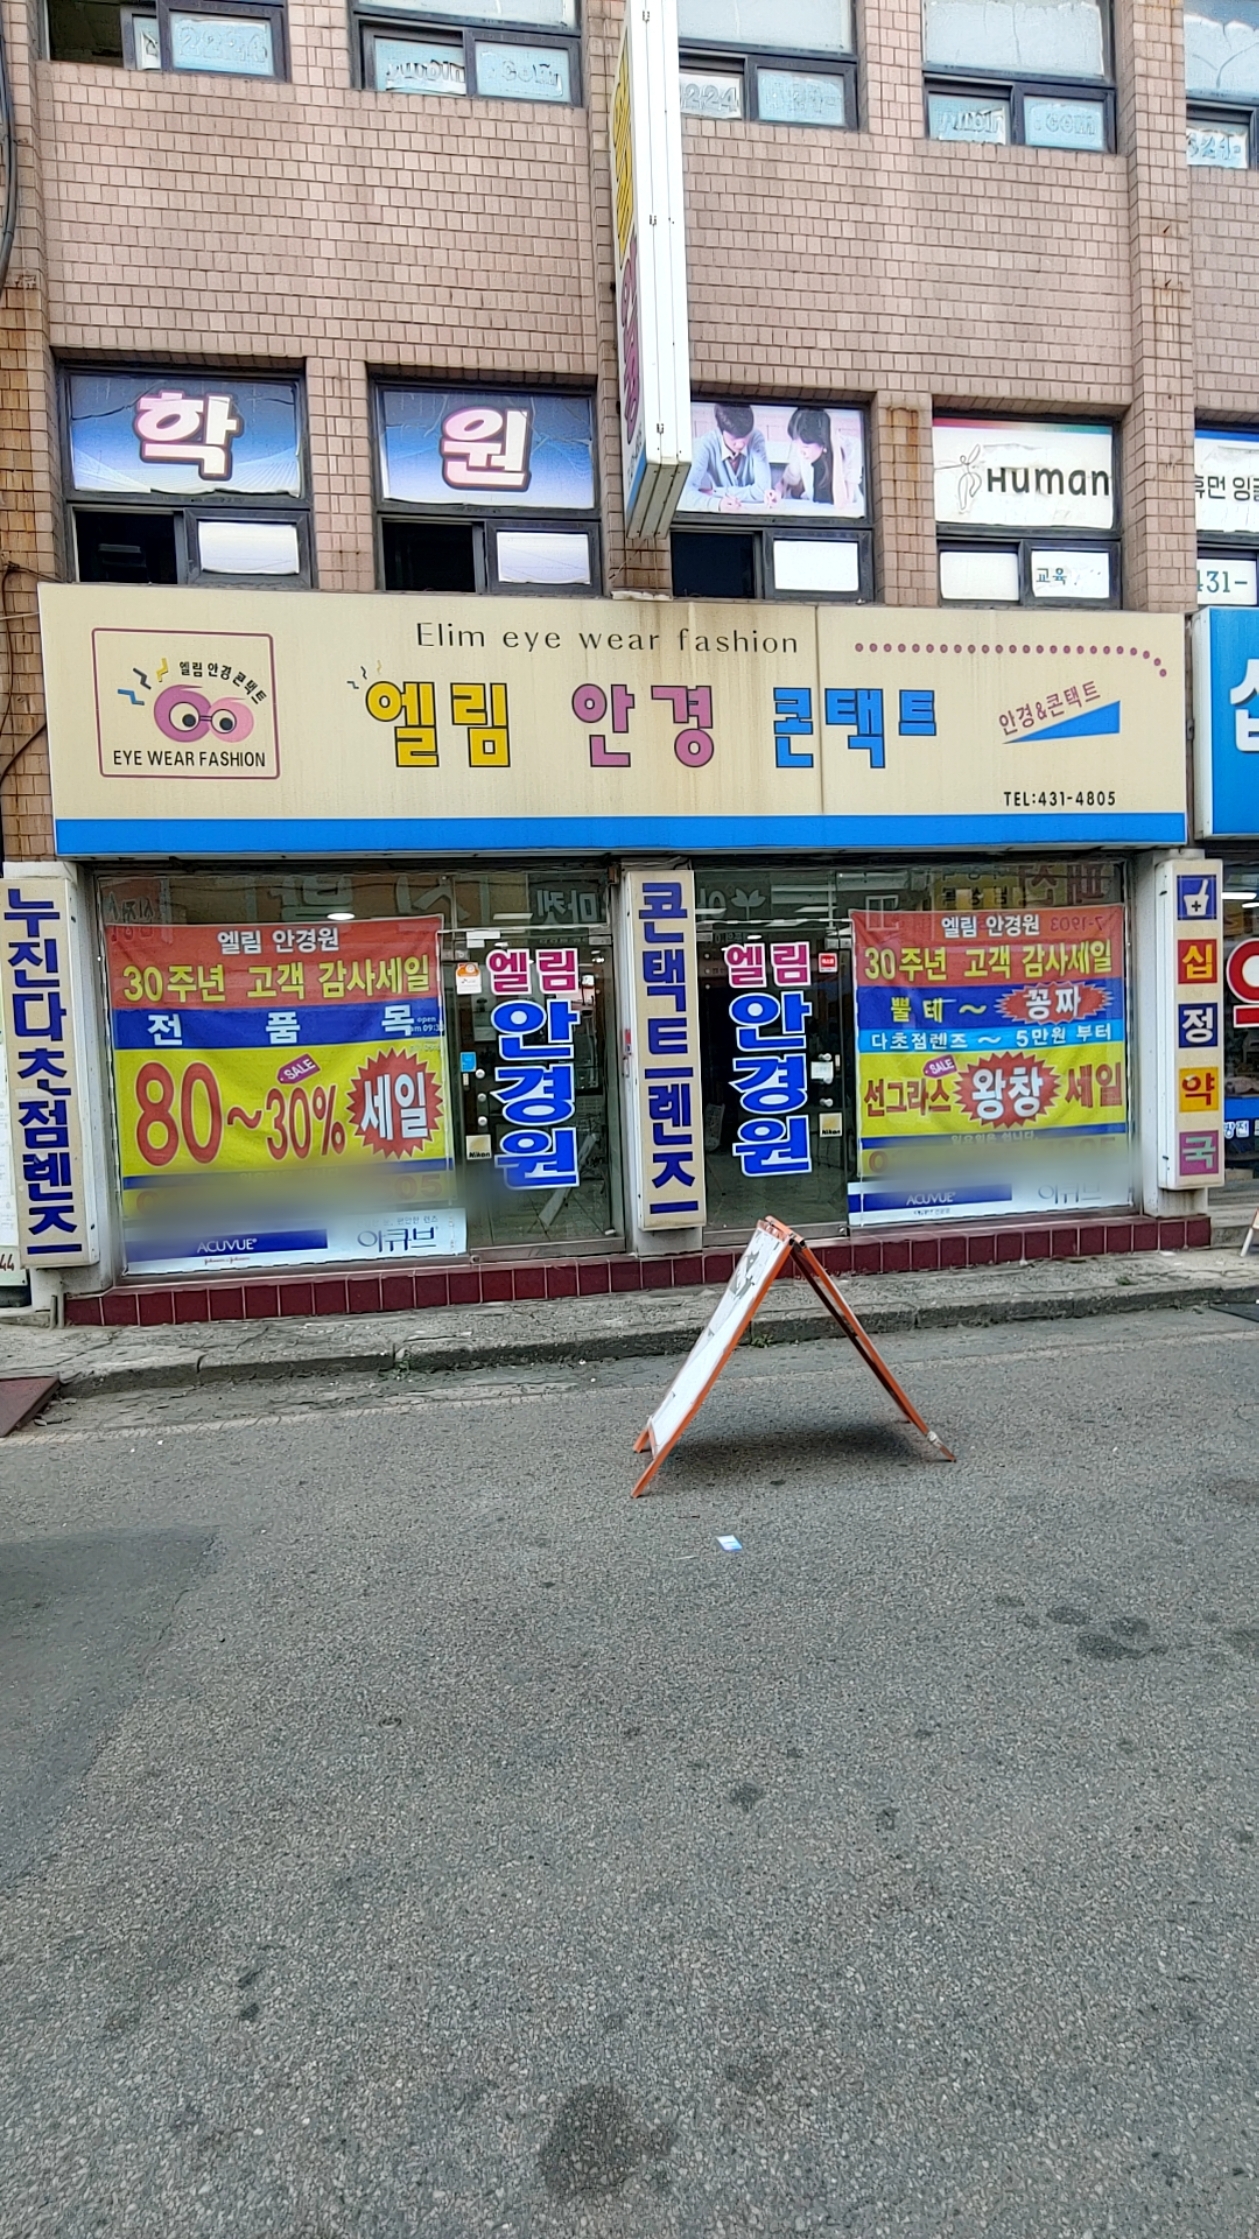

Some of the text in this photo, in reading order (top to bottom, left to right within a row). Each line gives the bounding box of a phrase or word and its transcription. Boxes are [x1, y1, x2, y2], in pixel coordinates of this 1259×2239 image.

[135, 392, 242, 479] 학
[442, 407, 530, 490] 원
[986, 467, 1110, 497] Human
[416, 622, 799, 654] Elim eye wear fashion
[179, 661, 203, 677] 엘림
[207, 662, 232, 681] 안경
[365, 680, 937, 769] 엘림 안경 콘택트
[113, 750, 266, 767] EYE WEAR FASHION
[1003, 790, 1116, 807] TEL:431-4805
[217, 927, 340, 955] 엘림 안경원
[941, 914, 1040, 939] 엘림 안경원
[123, 963, 226, 1003] 30주년
[246, 960, 306, 1000] 고객
[318, 954, 430, 999] 감사세일
[487, 949, 579, 994] 엘림
[724, 942, 811, 987] 엘림
[864, 938, 1113, 982] 30주년 고객 감사세일
[638, 881, 699, 1215] 콘택트렌즈
[871, 1031, 969, 1051] 다초점렌즈
[1016, 1026, 1067, 1048] 5만원
[1076, 1023, 1112, 1041] 부터
[283, 1057, 317, 1081] SALE
[729, 991, 812, 1176] 안경원
[928, 1057, 955, 1075] SALE
[360, 1070, 429, 1141] 세일
[491, 999, 580, 1189] 안경원
[863, 1061, 1123, 1120] 선그라스 왕창 세일
[135, 1060, 346, 1167] 80~30%
